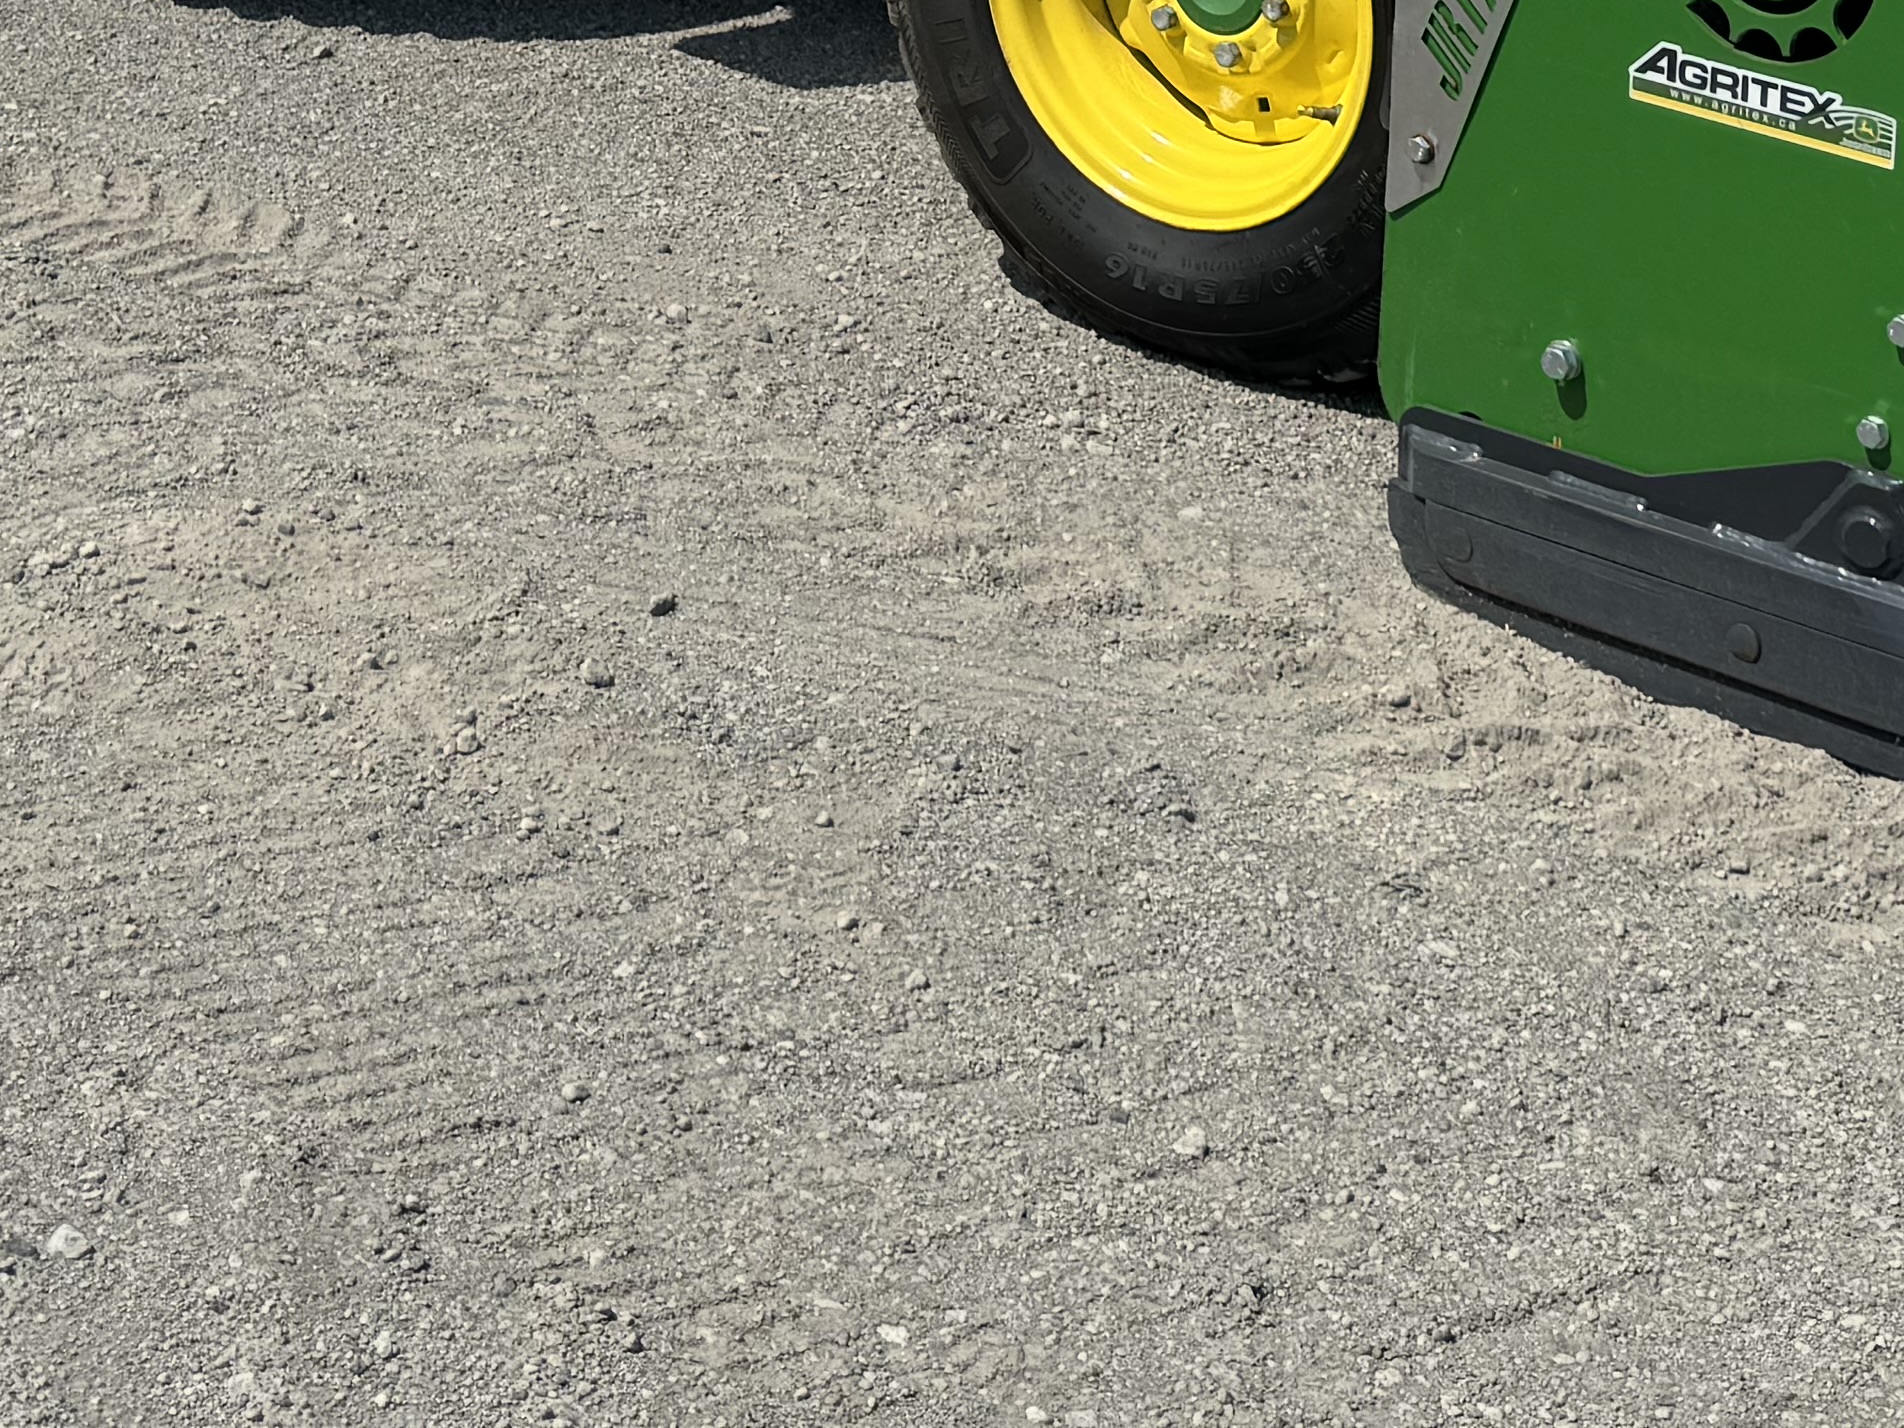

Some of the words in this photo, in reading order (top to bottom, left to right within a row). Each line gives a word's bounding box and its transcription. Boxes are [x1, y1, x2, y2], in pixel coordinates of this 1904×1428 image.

[937, 21, 1012, 159] TRI
[1634, 45, 1844, 127] AGRITEX
[1668, 88, 1797, 132] www.agritex.ca
